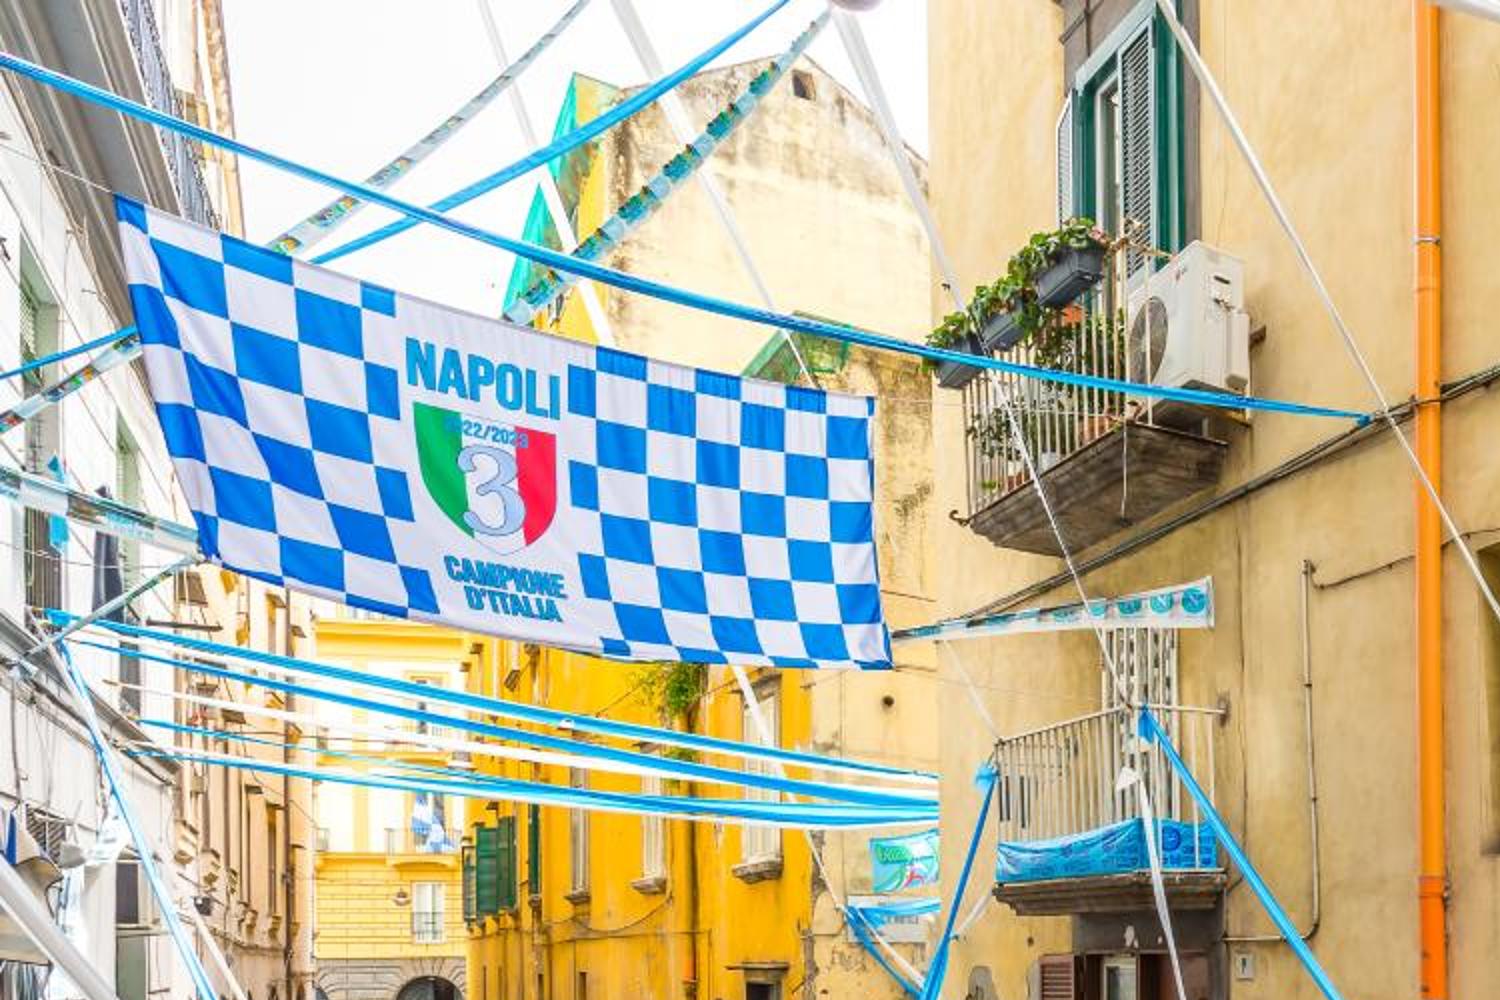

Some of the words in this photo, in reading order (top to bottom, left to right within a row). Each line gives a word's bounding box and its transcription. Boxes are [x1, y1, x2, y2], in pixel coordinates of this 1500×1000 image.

[405, 336, 561, 421] NAPOLI
[443, 415, 529, 449] 22/2023
[457, 445, 527, 537] 3
[443, 554, 568, 599] CAMPIONE
[463, 585, 563, 622] D'ITALIA
